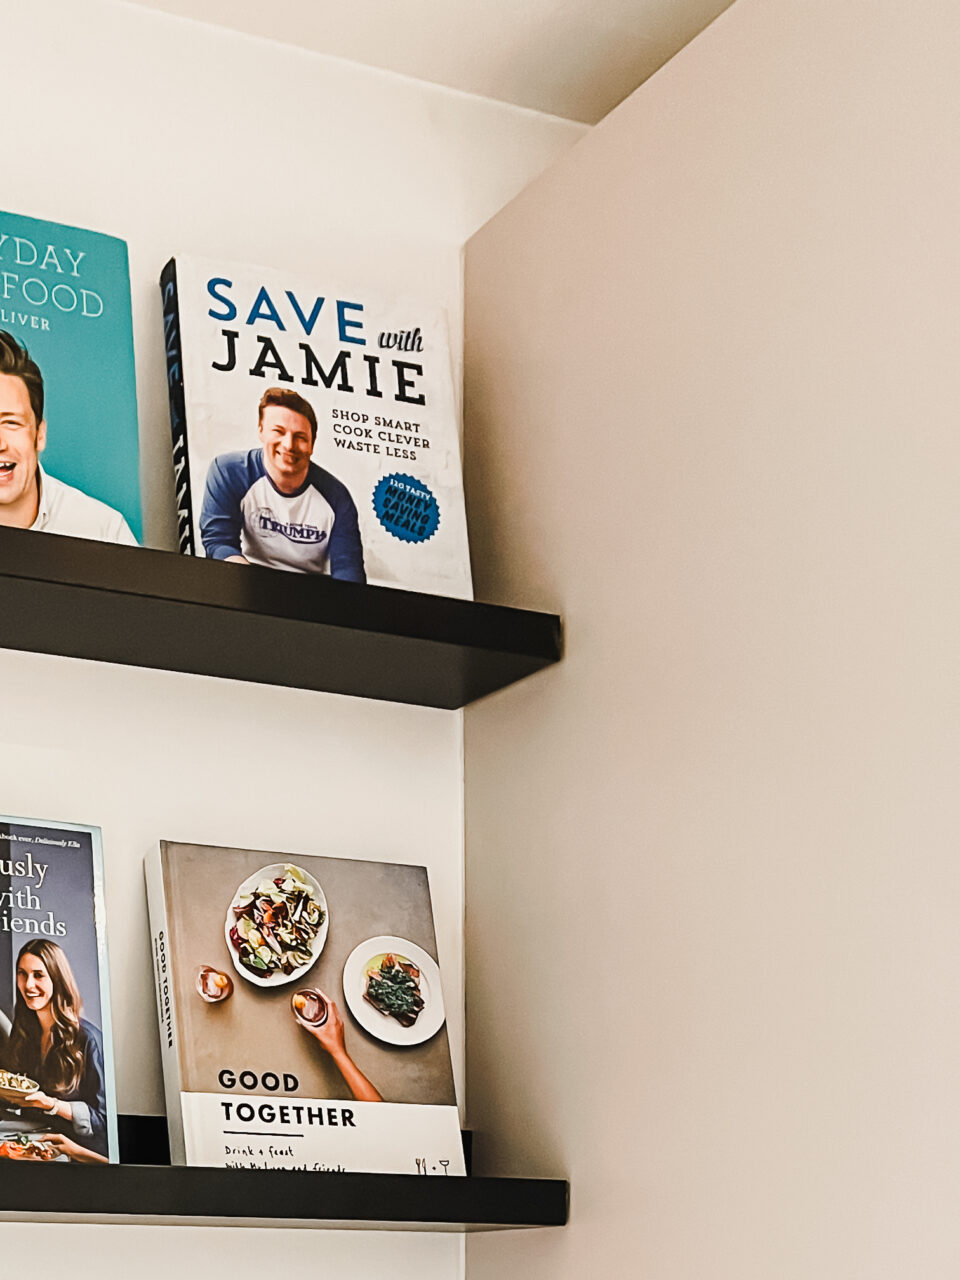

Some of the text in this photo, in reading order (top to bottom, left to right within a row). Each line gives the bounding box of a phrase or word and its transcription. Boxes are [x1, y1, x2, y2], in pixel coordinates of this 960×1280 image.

[1, 272, 103, 317] FOOD
[207, 277, 423, 353] SAVE with
[212, 329, 426, 406] JAMIE
[332, 409, 420, 433] SHOP SMART
[333, 424, 430, 448] COOK CLEVER
[334, 438, 416, 460] WASTE LESS
[385, 486, 432, 512] MONEY
[406, 485, 430, 500] TASTY
[383, 498, 430, 524] SAVING
[383, 511, 426, 536] MEALS
[218, 1070, 299, 1092] GOOD
[221, 1101, 356, 1127] TOGETHER
[225, 1146, 294, 1158] Drink feast
